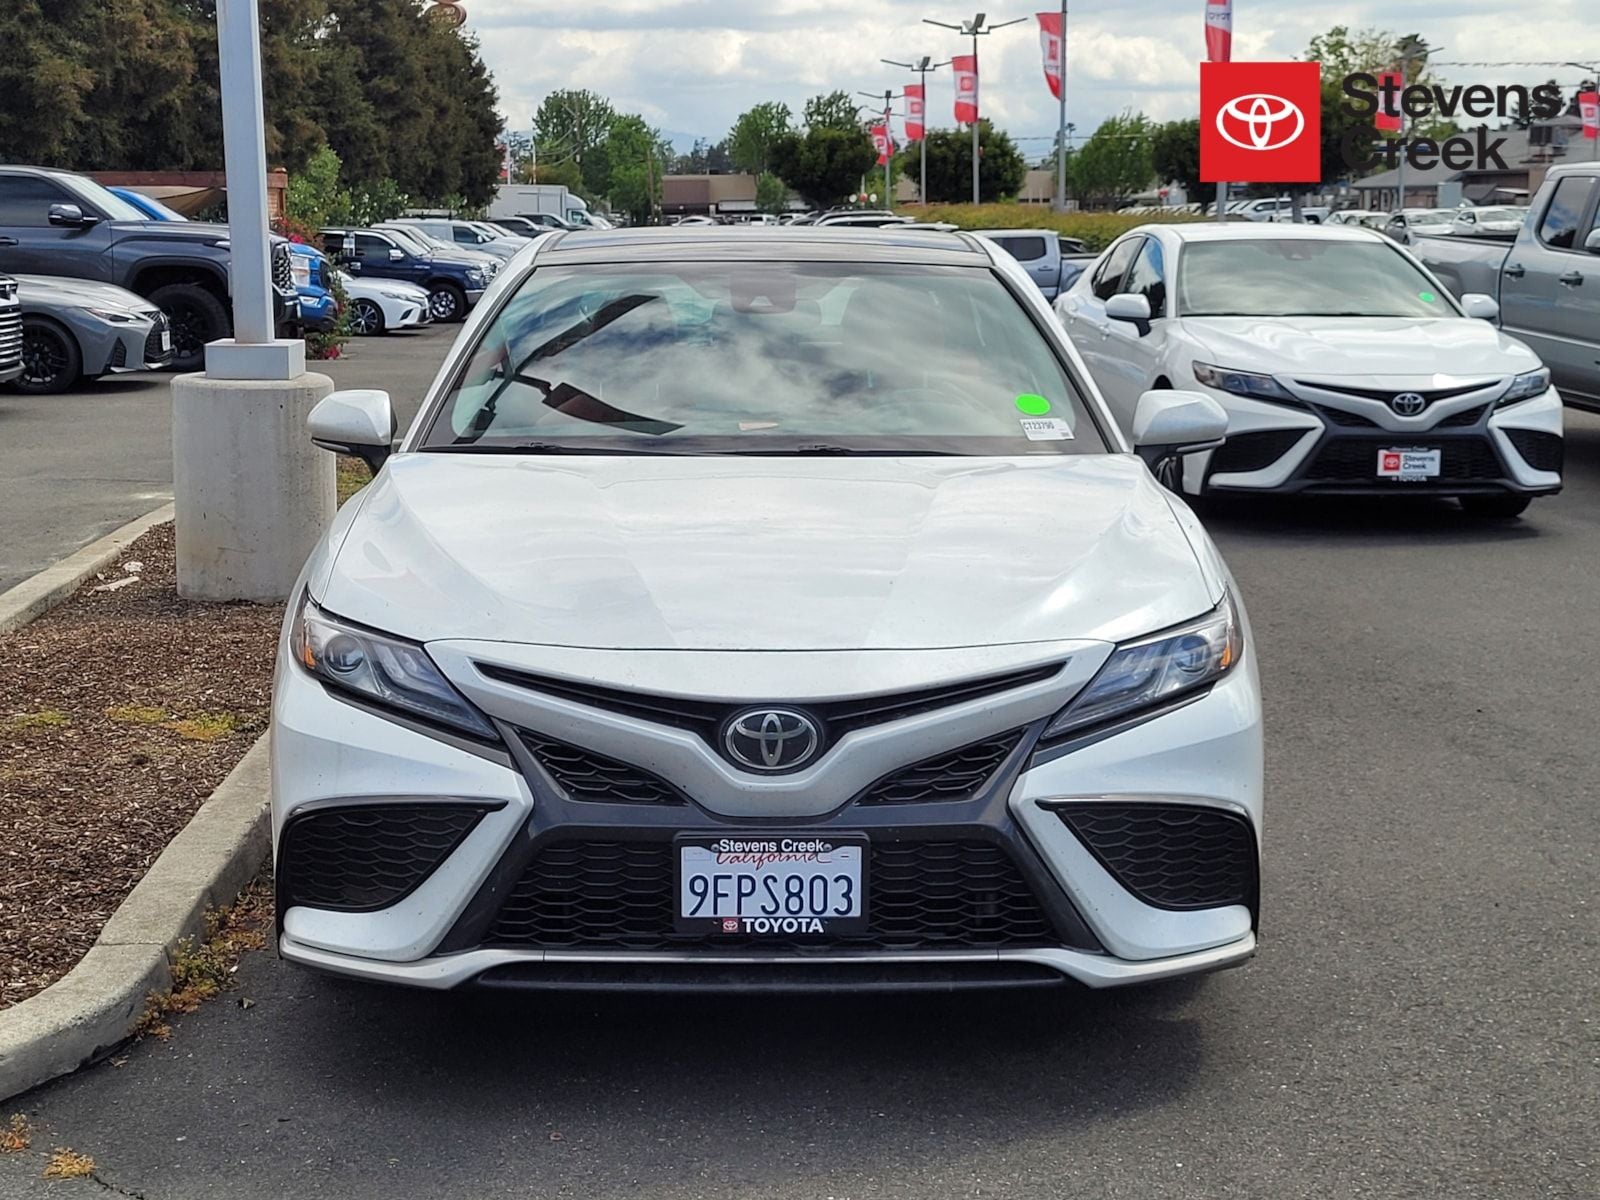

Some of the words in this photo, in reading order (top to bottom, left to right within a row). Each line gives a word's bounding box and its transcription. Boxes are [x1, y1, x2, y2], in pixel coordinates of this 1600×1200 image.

[719, 838, 778, 853] Stevens
[781, 838, 824, 853] Creek
[689, 874, 853, 916] 9FPS803
[742, 918, 825, 933] TOYOTA
